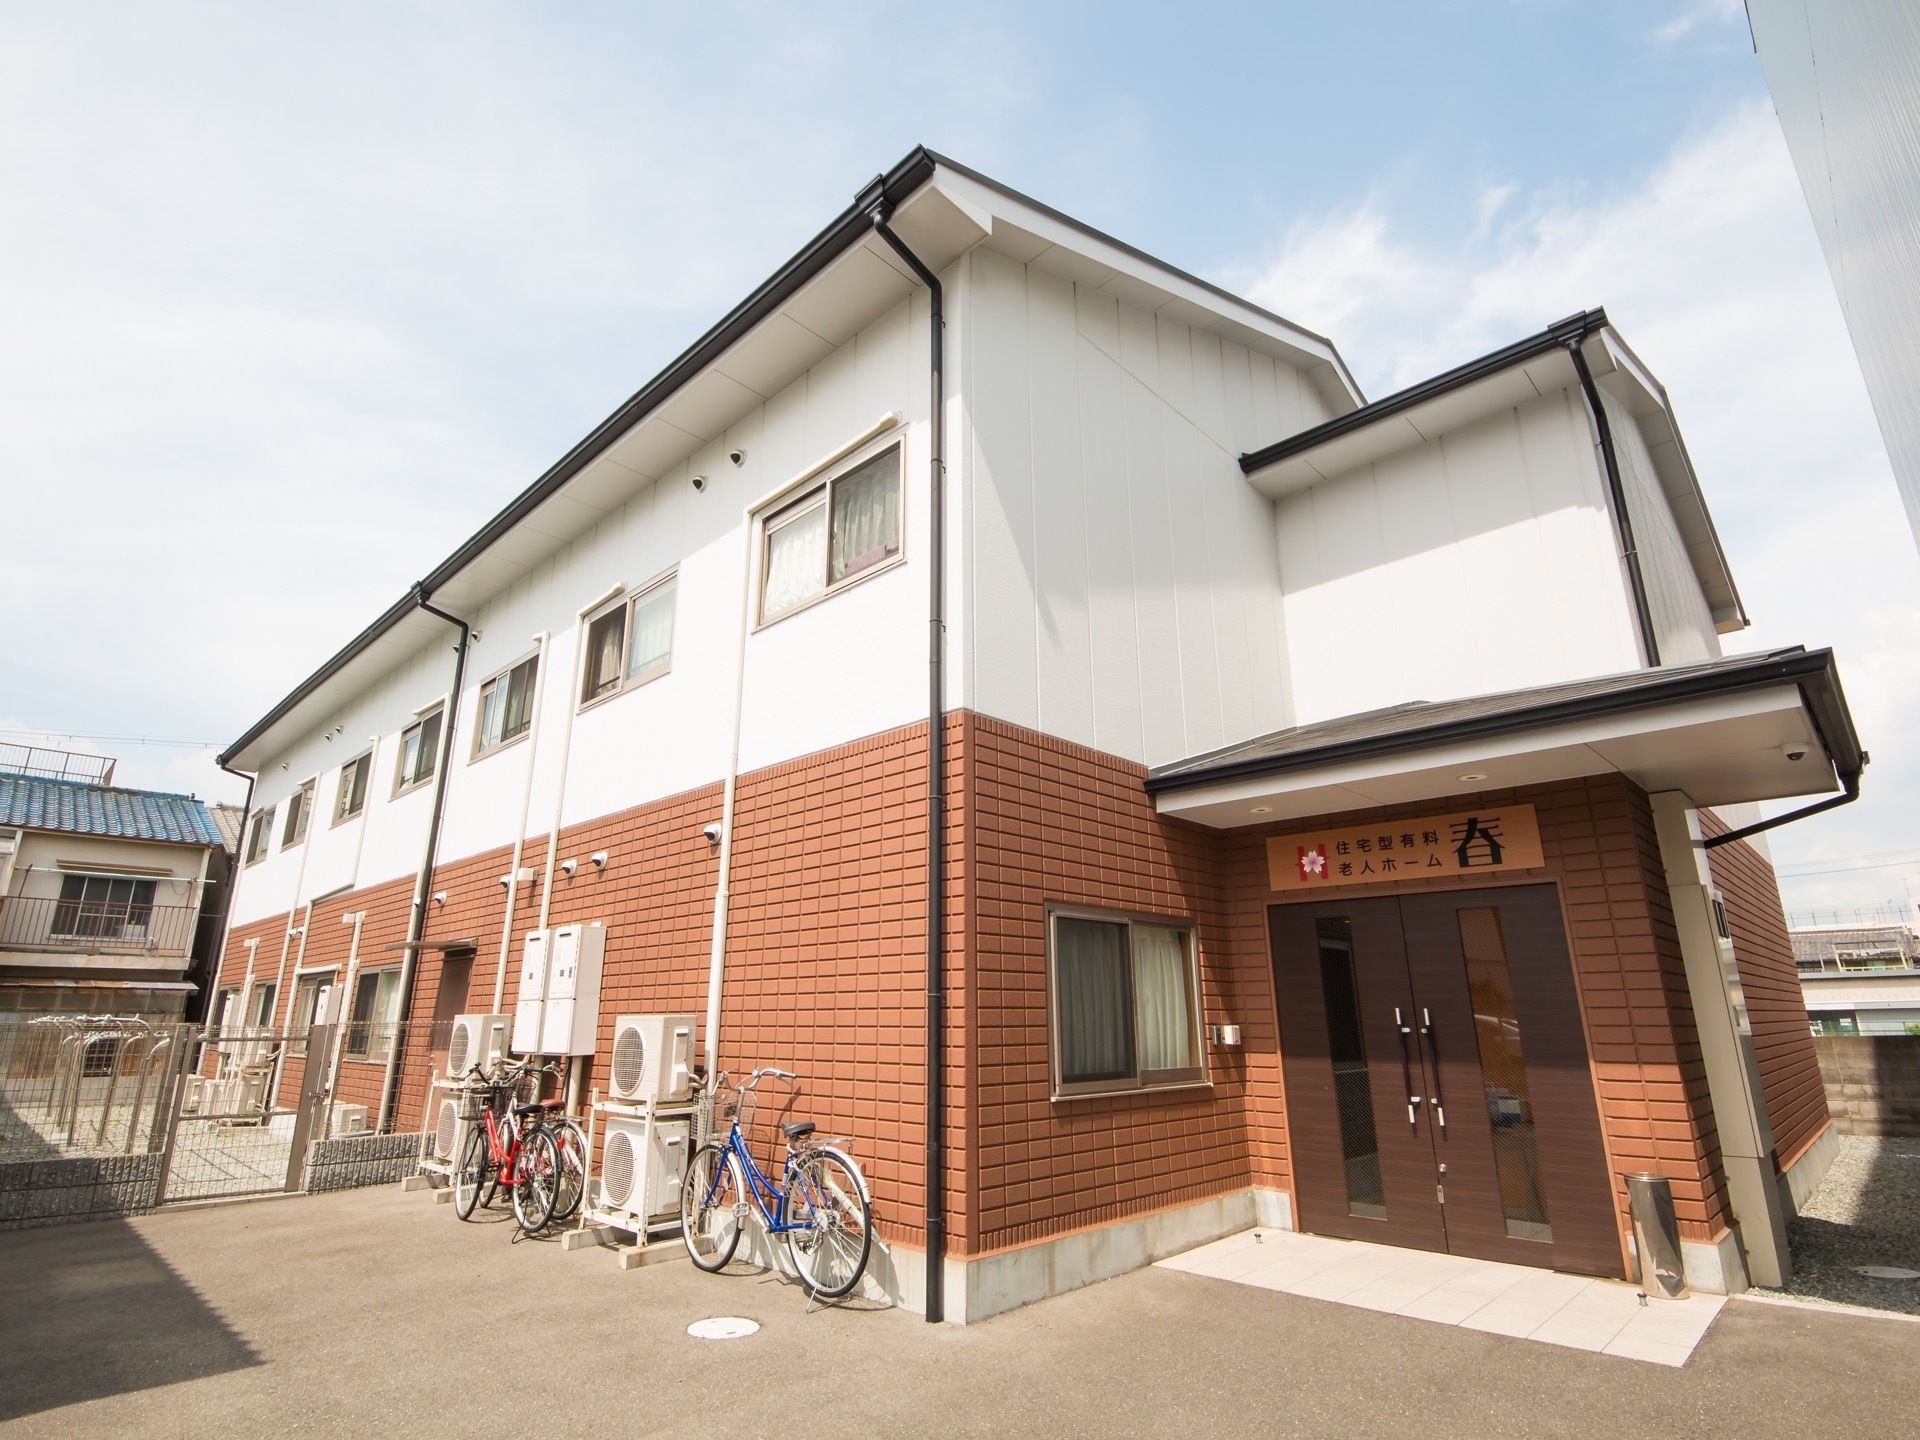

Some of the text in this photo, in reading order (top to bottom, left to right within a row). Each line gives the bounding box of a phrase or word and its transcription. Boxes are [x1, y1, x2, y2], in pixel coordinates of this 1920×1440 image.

[1335, 830, 1439, 855] 住宅型有料
[1449, 817, 1505, 868] 春
[1339, 854, 1442, 876] 老人ホーム
